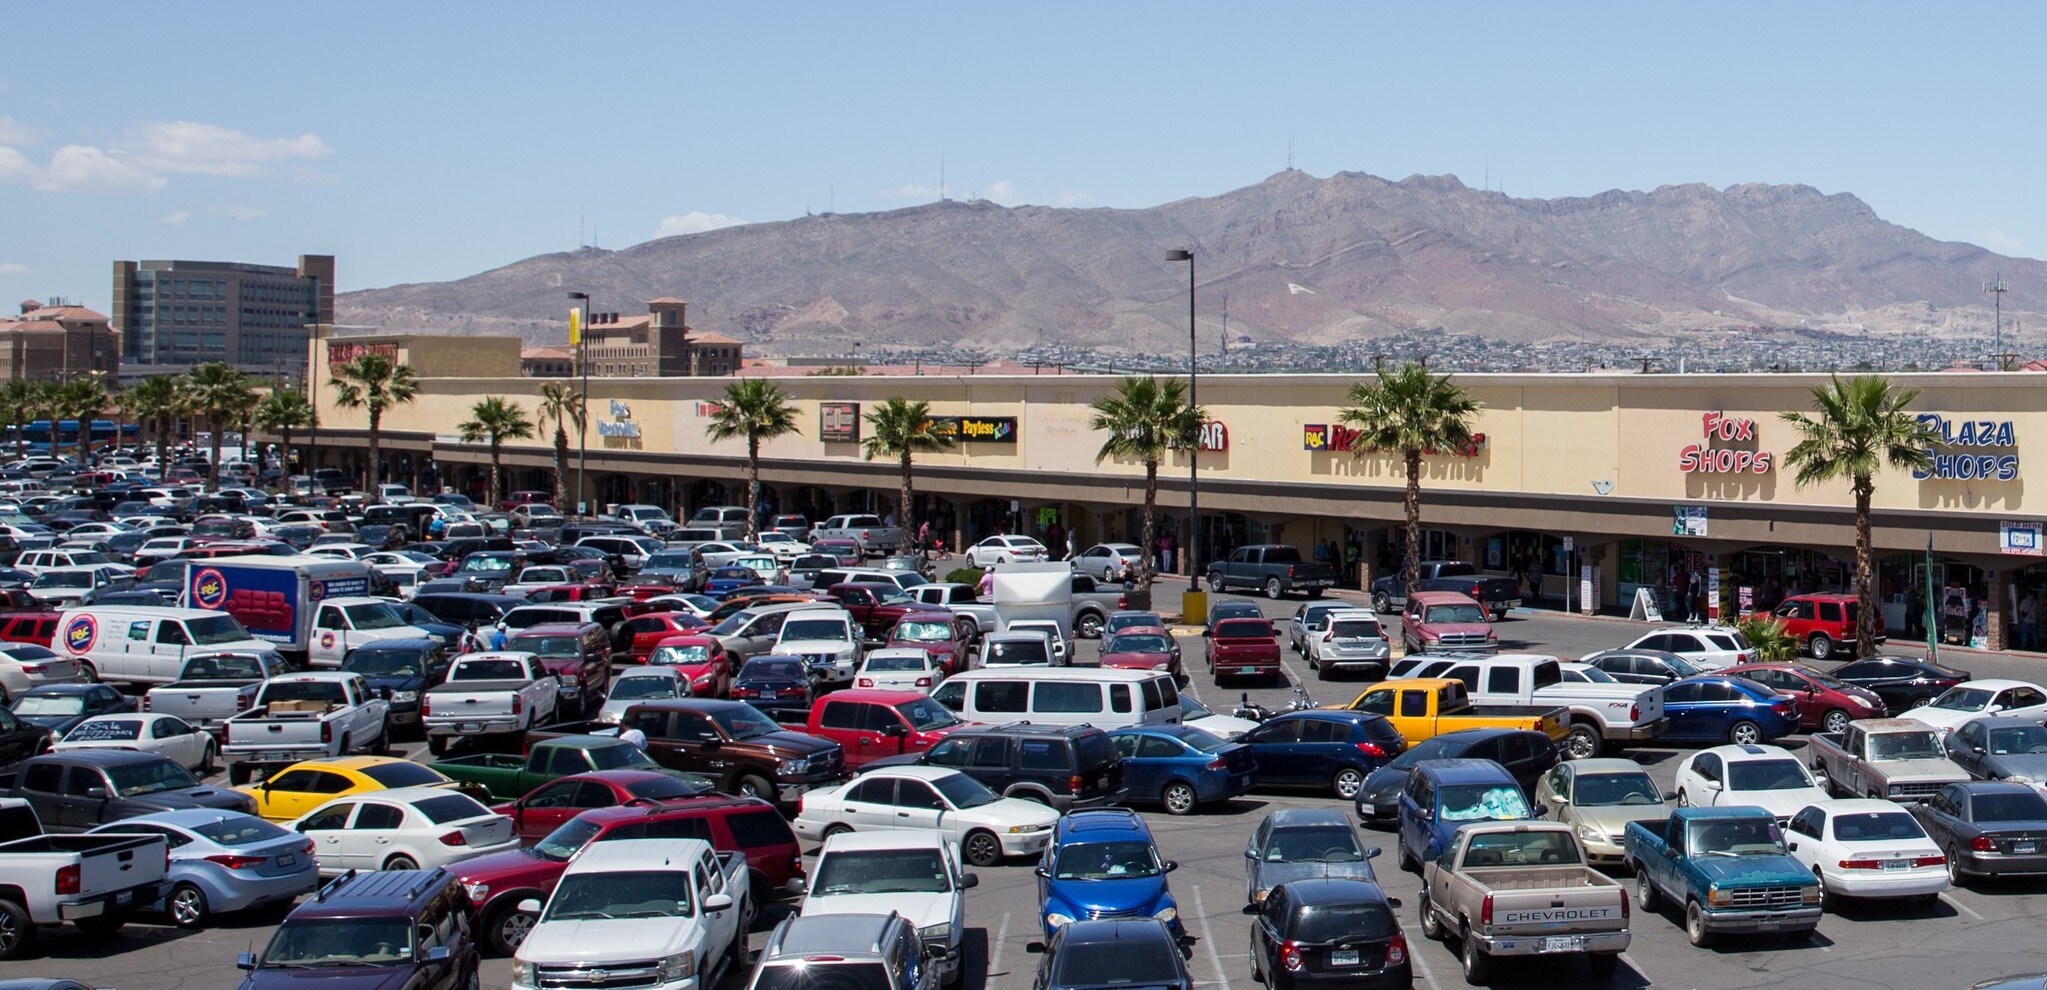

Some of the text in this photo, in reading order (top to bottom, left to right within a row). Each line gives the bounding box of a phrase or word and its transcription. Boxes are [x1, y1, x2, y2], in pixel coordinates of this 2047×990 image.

[962, 420, 994, 438] Payless
[1702, 410, 1752, 441] FOX
[1916, 413, 2014, 447] PLAZA
[1305, 431, 1325, 449] RAC
[1680, 443, 1770, 474] SHOPS
[70, 626, 89, 640] RAC
[1506, 909, 1609, 922] CHEVROLET
